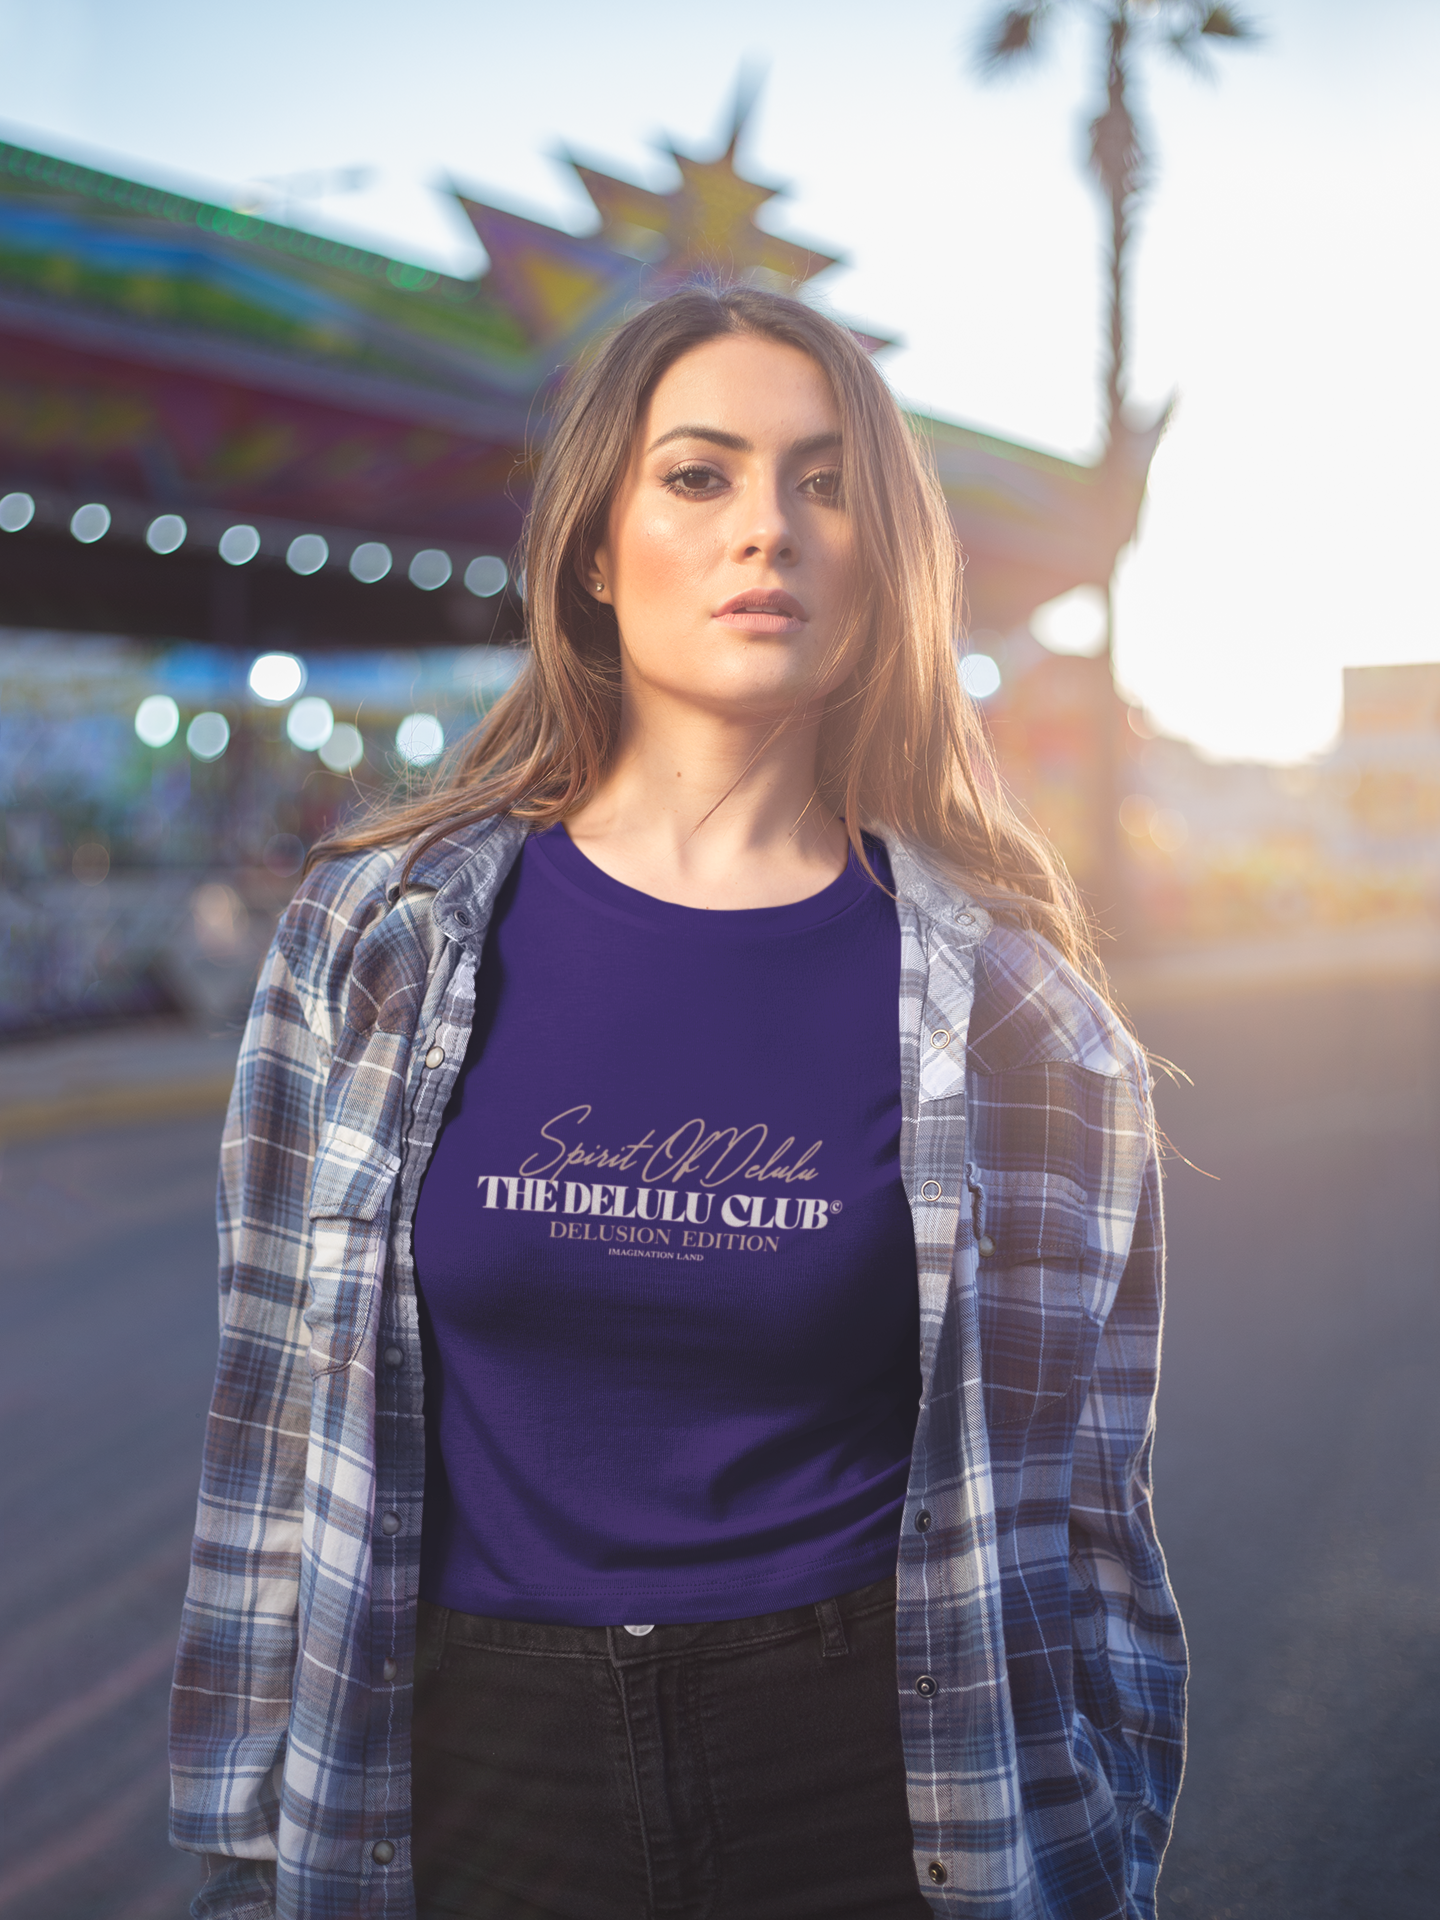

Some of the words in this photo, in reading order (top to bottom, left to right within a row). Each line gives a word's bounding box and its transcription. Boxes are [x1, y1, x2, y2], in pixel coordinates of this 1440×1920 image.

[519, 1104, 655, 1184] Spirit
[700, 1123, 823, 1188] Delulu
[477, 1175, 559, 1213] THE
[561, 1180, 716, 1225] DELULU
[549, 1221, 671, 1246] DELUSION
[682, 1230, 780, 1252] EDITION
[608, 1248, 675, 1260] IMAGINATION
[676, 1253, 704, 1261] LAND
